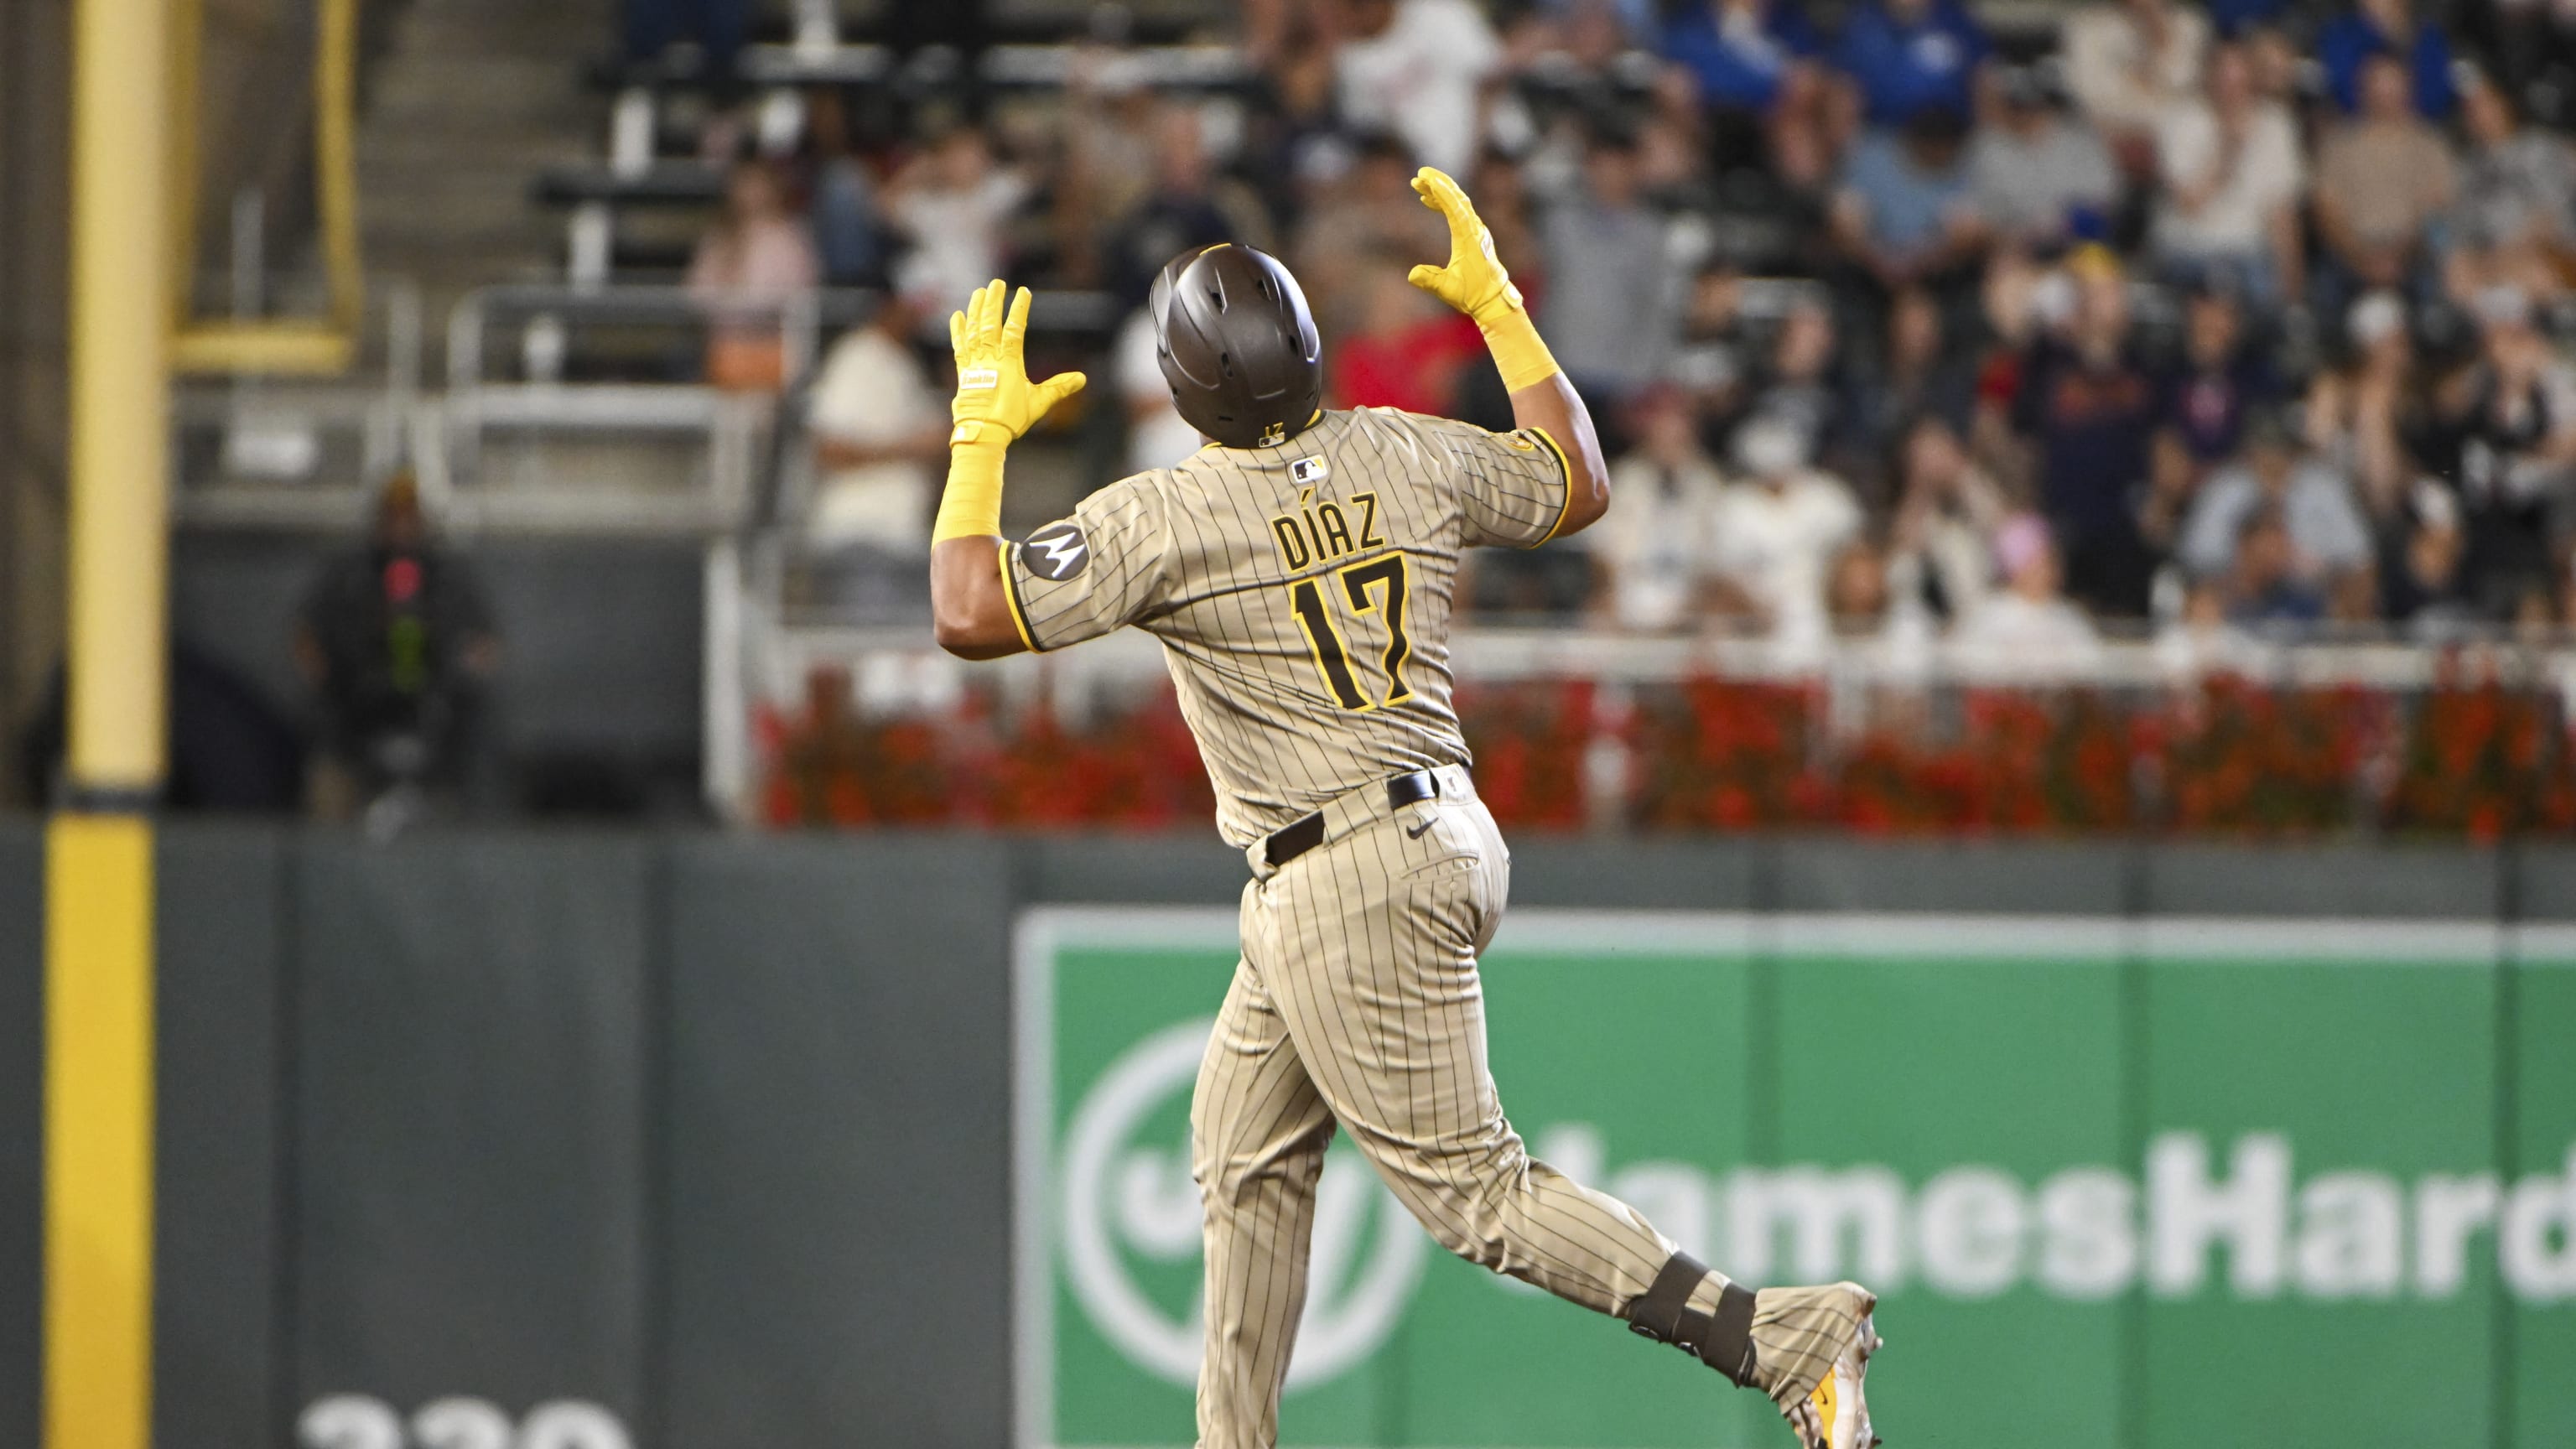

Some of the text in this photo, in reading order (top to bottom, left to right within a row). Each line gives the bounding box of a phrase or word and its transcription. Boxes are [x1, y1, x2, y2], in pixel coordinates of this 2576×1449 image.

[1265, 422, 1284, 438] 17
[1271, 486, 1385, 574] DÍAZ
[1289, 549, 1415, 713] 17
